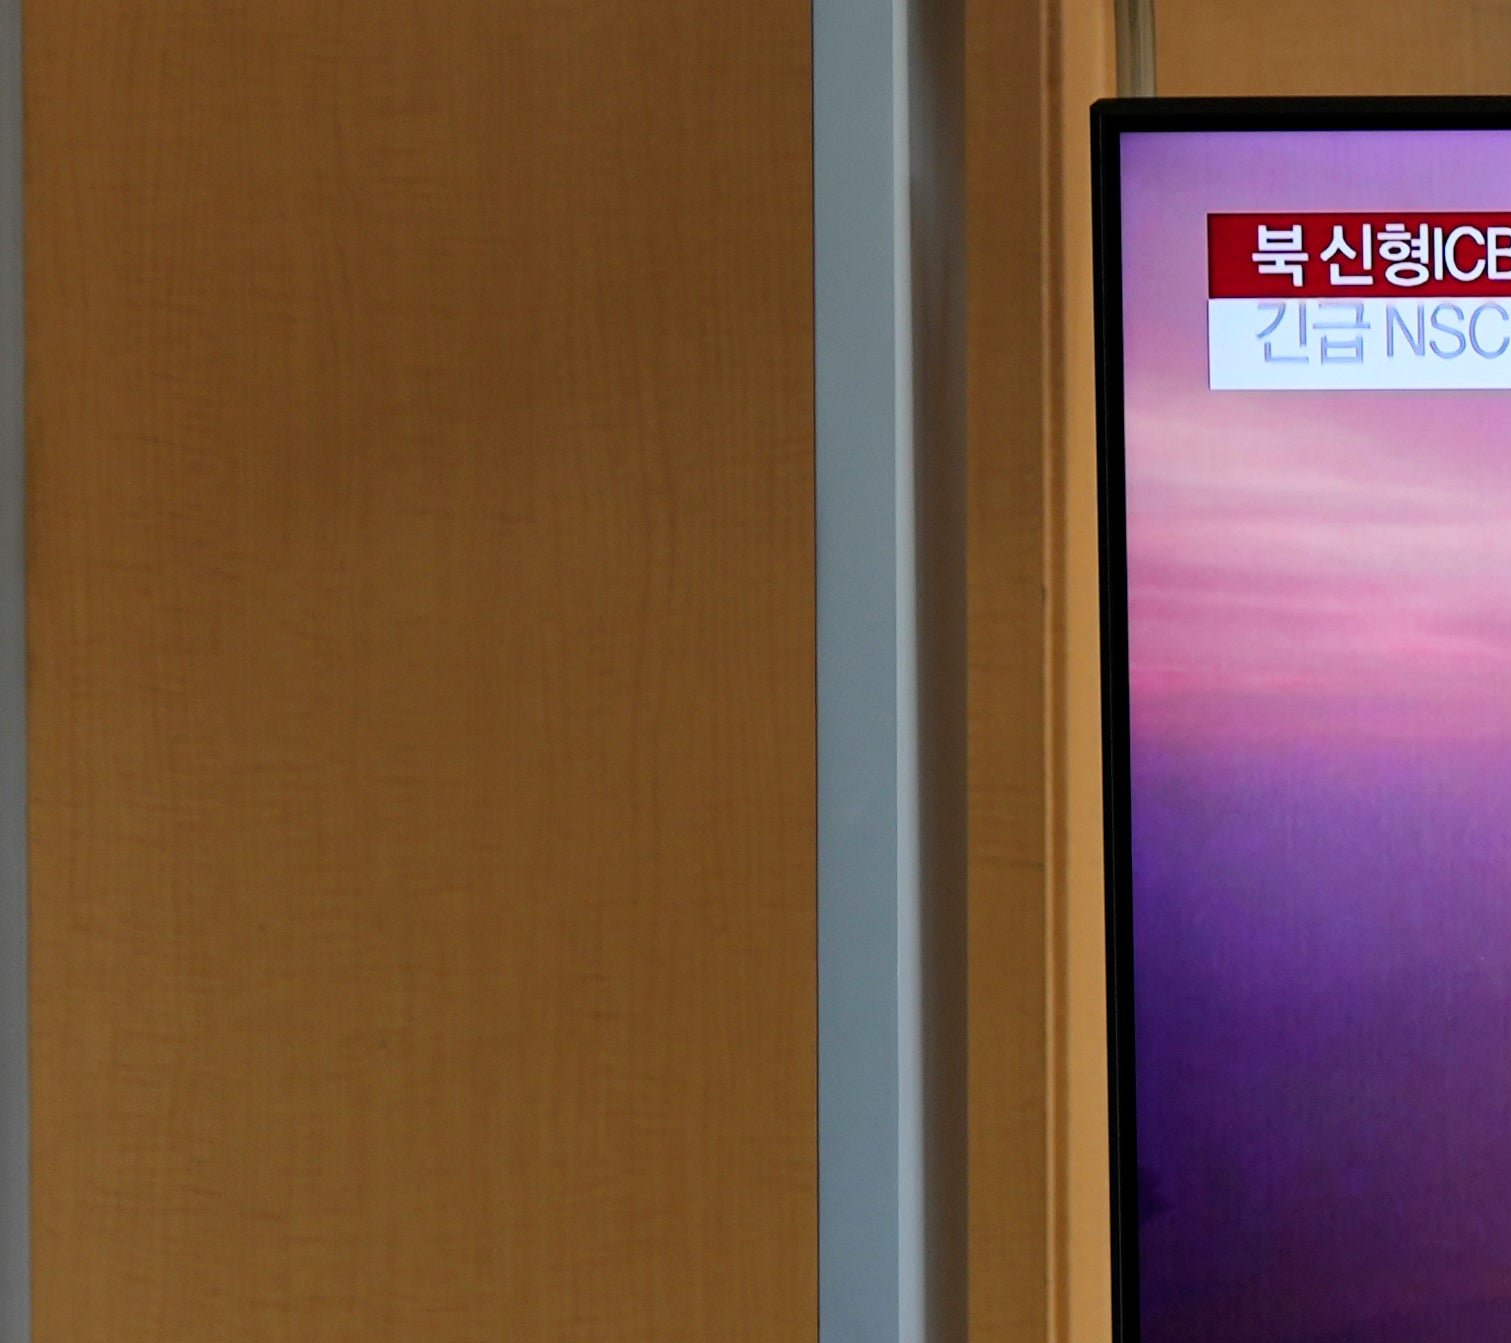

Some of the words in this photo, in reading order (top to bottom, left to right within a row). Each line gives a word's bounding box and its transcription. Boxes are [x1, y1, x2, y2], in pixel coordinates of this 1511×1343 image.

[1251, 223, 1309, 286] 북
[1254, 300, 1371, 366] 긴급
[1386, 301, 1511, 361] NSC
